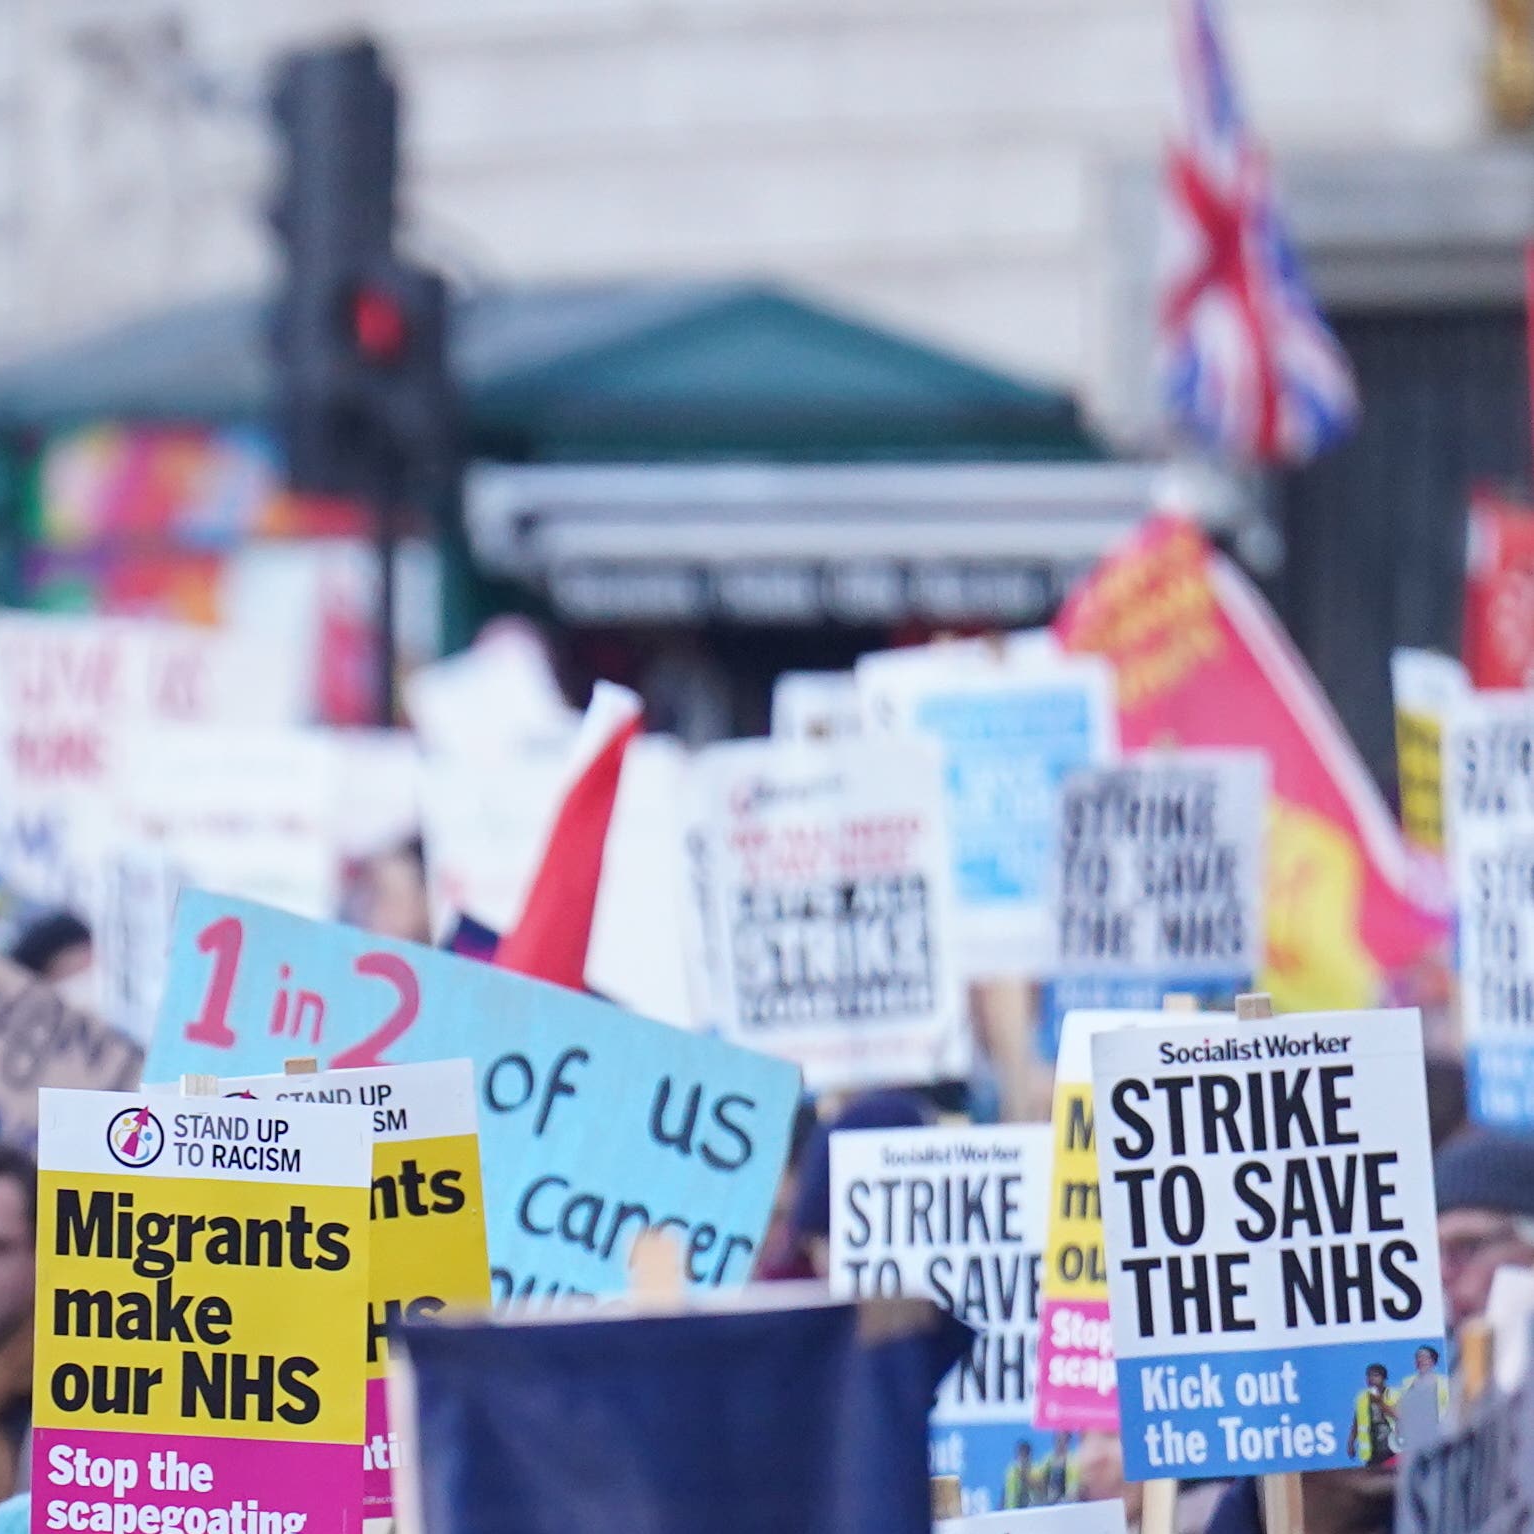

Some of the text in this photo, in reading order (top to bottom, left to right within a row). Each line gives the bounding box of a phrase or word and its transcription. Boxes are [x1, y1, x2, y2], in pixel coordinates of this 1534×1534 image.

[184, 915, 245, 1050] 1
[268, 961, 329, 1045] in
[328, 950, 422, 1070] 2
[481, 1045, 591, 1138] of
[647, 1073, 756, 1173] us
[1159, 1032, 1353, 1066] Socialist Worker
[360, 1083, 393, 1106] UP
[1111, 1065, 1360, 1161] STRIKE
[174, 1113, 290, 1144] STAND UP
[174, 1141, 302, 1174] TO RACISM
[54, 1188, 351, 1279] Migrants
[844, 1172, 1023, 1249] STRIKE
[1114, 1165, 1206, 1249] TO
[1233, 1151, 1404, 1245] SAVE
[53, 1277, 233, 1345] make
[1121, 1238, 1423, 1339] THE NHS
[51, 1350, 321, 1425] our NHS
[957, 1341, 1037, 1407] NH
[1139, 1360, 1300, 1413] Kick out
[47, 1443, 214, 1497] Stop the
[1144, 1415, 1337, 1467] the Tories
